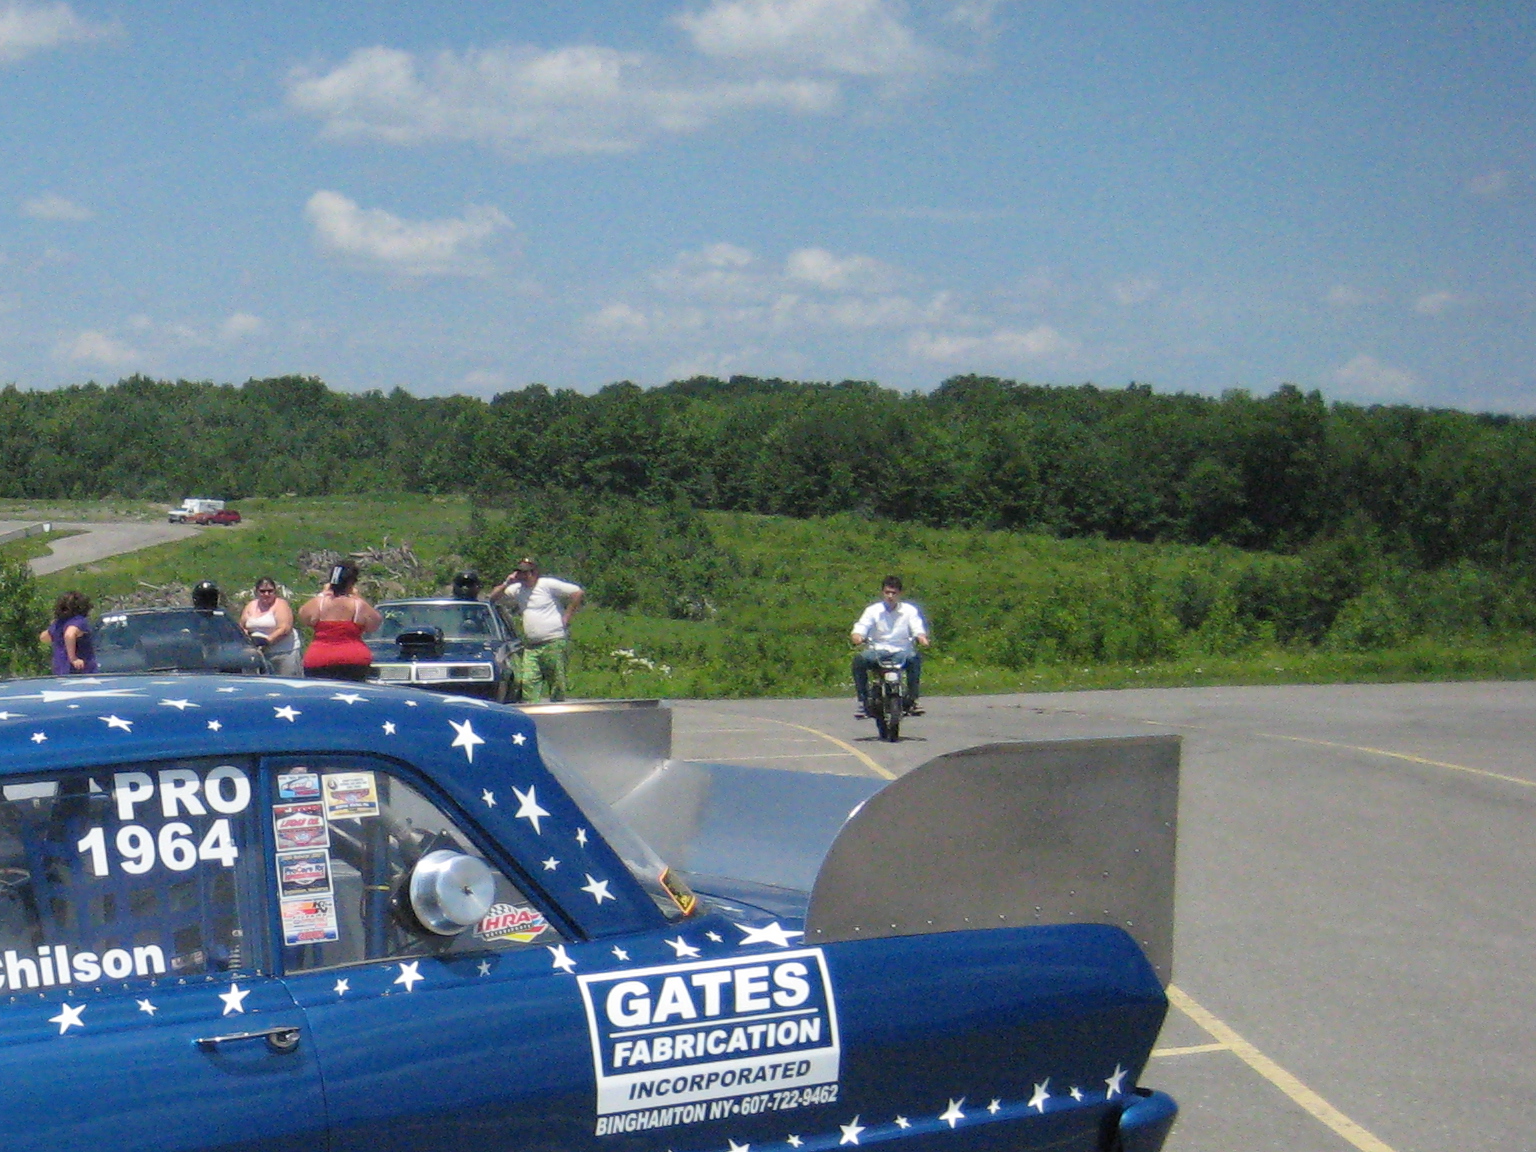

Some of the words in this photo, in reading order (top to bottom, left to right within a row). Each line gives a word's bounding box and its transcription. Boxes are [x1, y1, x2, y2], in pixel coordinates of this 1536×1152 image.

[114, 765, 251, 820] PRO
[76, 819, 238, 876] 1964
[606, 962, 810, 1028] GATES
[613, 1018, 821, 1068] FABRICATION
[629, 1059, 811, 1100] INCORPORATED
[595, 1103, 706, 1136] BINGHAMTON
